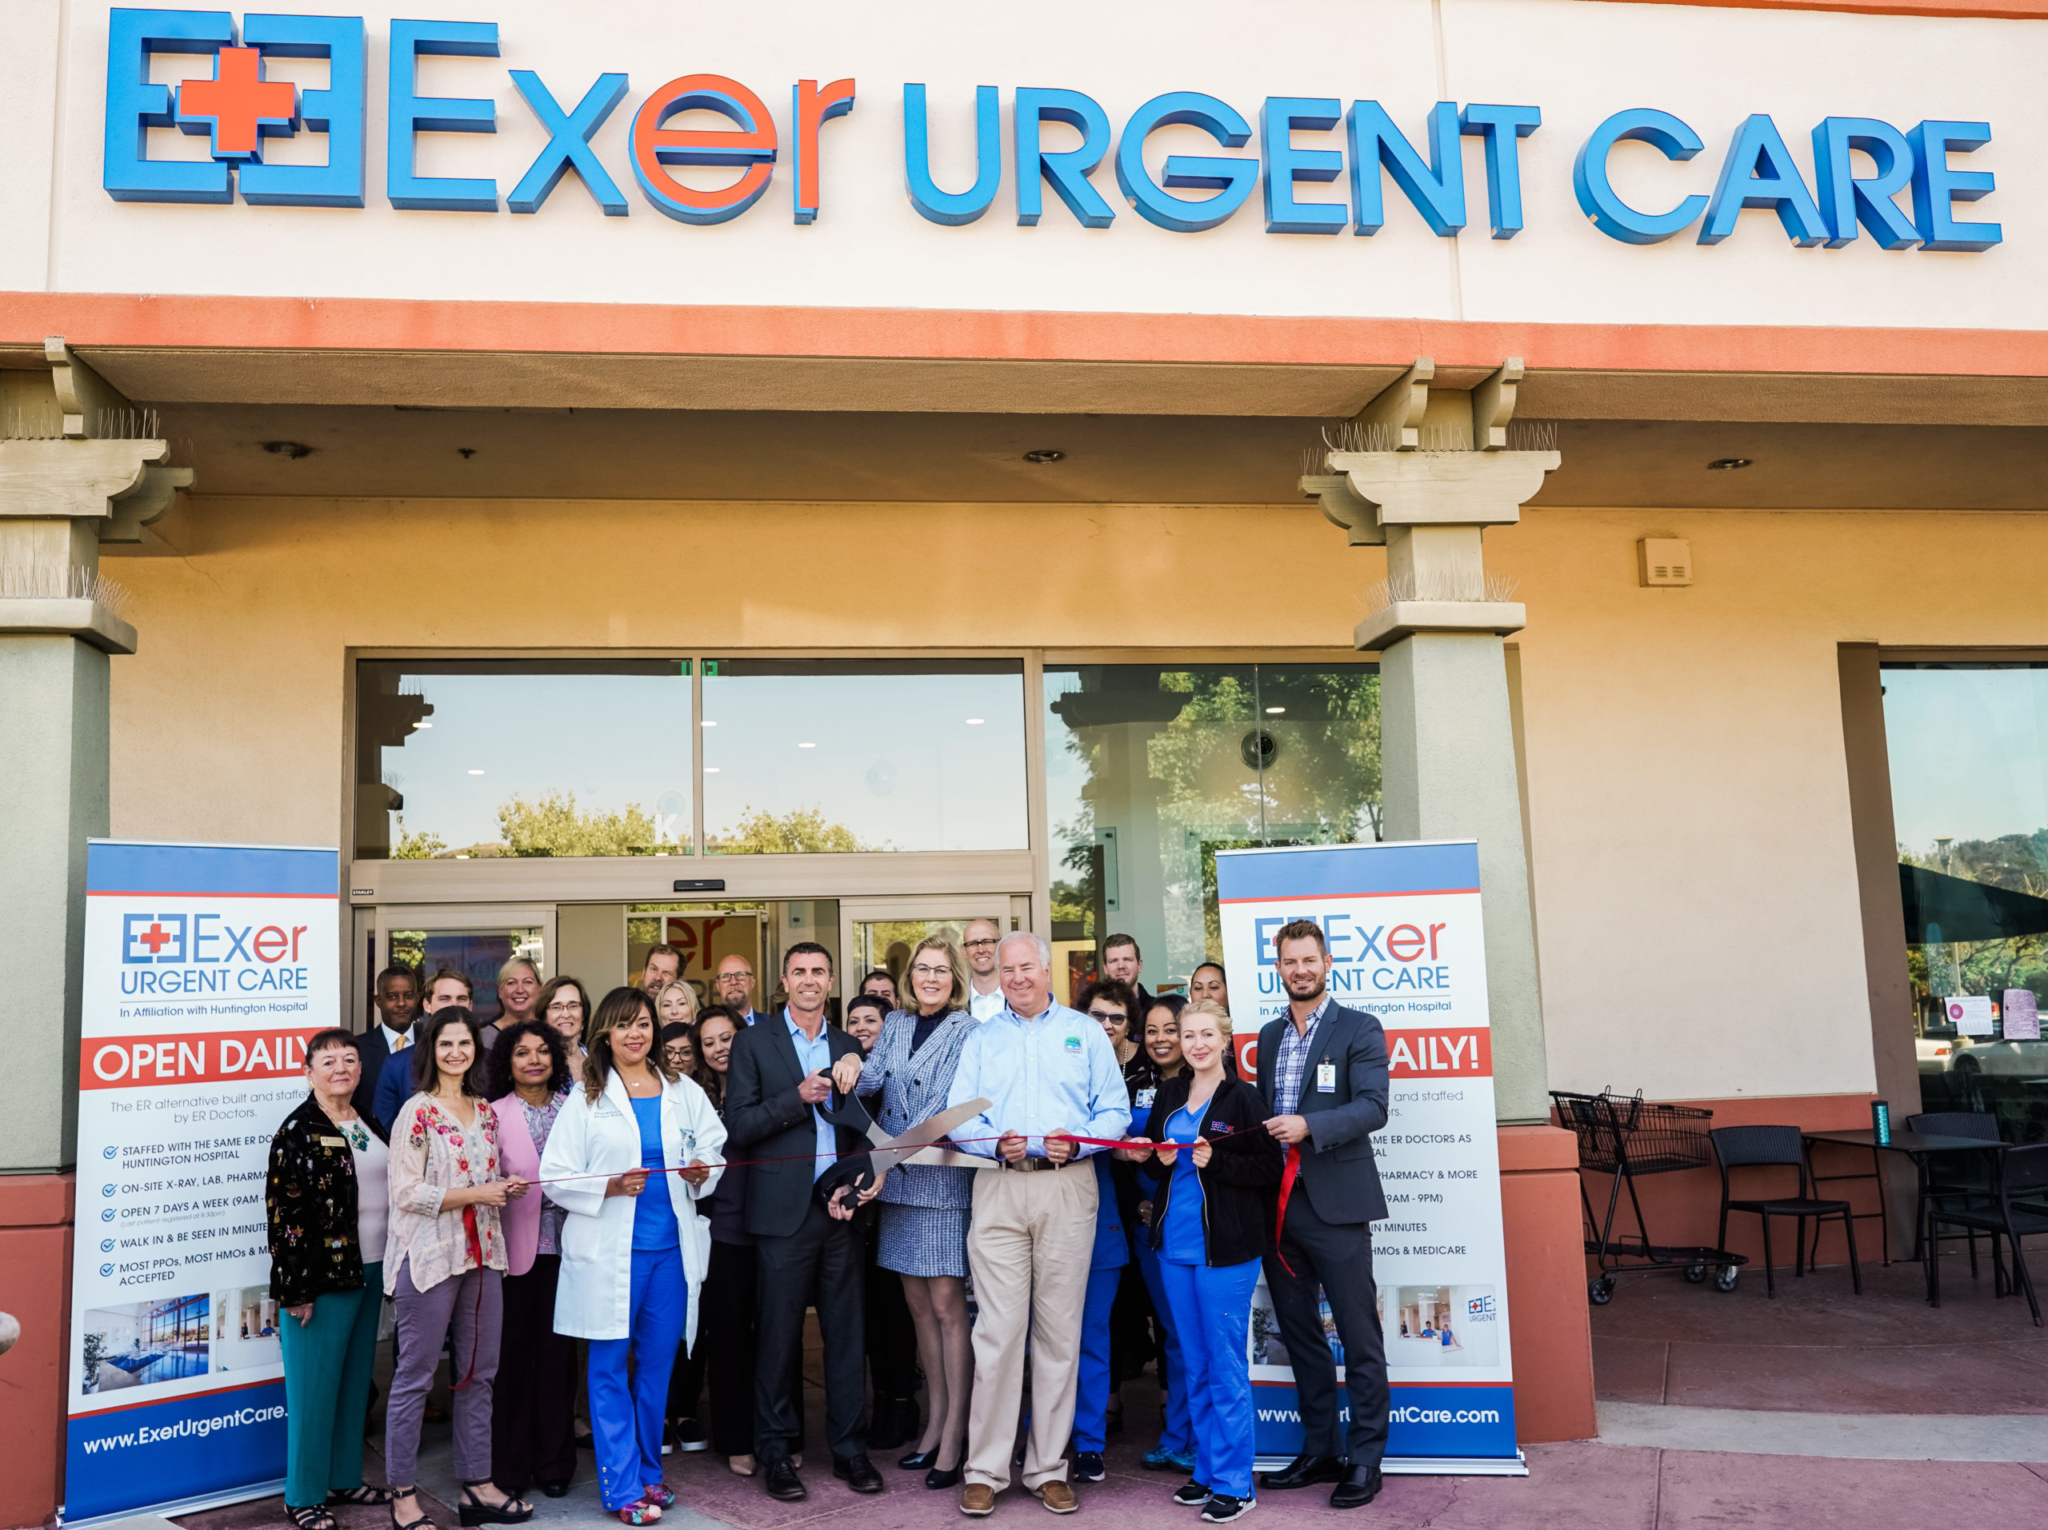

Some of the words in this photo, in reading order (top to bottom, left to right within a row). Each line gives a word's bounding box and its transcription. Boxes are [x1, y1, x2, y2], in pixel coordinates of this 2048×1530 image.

[387, 18, 856, 226] Exer
[903, 82, 1541, 240] URGENT
[1573, 108, 2002, 252] CARE
[193, 914, 307, 963] Exer
[1323, 914, 1446, 962] Exer
[121, 969, 230, 994] URGENT
[237, 967, 307, 991] CARE
[1372, 966, 1450, 990] CARE
[120, 1008, 130, 1017] In
[133, 1007, 183, 1017] Affiliation
[187, 1006, 207, 1016] with
[210, 1004, 266, 1015] Huntington
[269, 1002, 308, 1013] Hospital
[1259, 1006, 1269, 1015] In
[1408, 1001, 1452, 1013] Hospital
[93, 1041, 205, 1081] OPEN
[1388, 1035, 1479, 1071] AILY!
[111, 1101, 132, 1112] The
[136, 1100, 152, 1111] ER
[155, 1097, 219, 1110] alternative
[223, 1094, 247, 1105] built
[250, 1091, 273, 1102] and
[1394, 1091, 1419, 1102] and
[1422, 1090, 1464, 1102] staffed
[174, 1112, 189, 1124] by
[192, 1110, 206, 1121] ER
[210, 1108, 257, 1121] Doctors.
[122, 1144, 164, 1156] STAFFED
[167, 1141, 191, 1152] WITH
[194, 1139, 211, 1150] THE
[213, 1137, 241, 1148] SAME
[244, 1136, 256, 1146] ER
[1391, 1135, 1403, 1144] ER
[1405, 1134, 1456, 1144] DOCTORS
[1458, 1134, 1472, 1143] AS
[122, 1155, 191, 1169] HUNTINGTON
[194, 1150, 240, 1163] HOSPITAL
[121, 1181, 163, 1194] ON-SITE
[166, 1178, 199, 1190] X-RAY,
[202, 1174, 223, 1186] LAB,
[1437, 1170, 1445, 1179] &
[1447, 1170, 1478, 1180] MORE
[121, 1206, 150, 1218] OPEN
[154, 1205, 160, 1215] 7
[163, 1202, 189, 1214] DAYS
[192, 1201, 199, 1210] A
[202, 1197, 229, 1209] WEEK
[232, 1194, 259, 1207] (9AM
[1417, 1194, 1443, 1203] 9PM)
[137, 1216, 160, 1227] patient
[161, 1213, 192, 1225] registered
[193, 1212, 200, 1220] at
[1371, 1223, 1381, 1232] IN
[1384, 1223, 1427, 1232] MINUTES
[120, 1237, 149, 1248] WALK
[152, 1235, 163, 1245] IN
[166, 1234, 174, 1243] &
[177, 1232, 188, 1242] BE
[191, 1229, 216, 1239] SEEN
[218, 1227, 229, 1237] IN
[232, 1222, 268, 1235] MINUTE
[119, 1260, 150, 1273] MOST
[152, 1257, 182, 1269] PPOs,
[185, 1254, 213, 1265] MOST
[216, 1249, 246, 1260] HMOs
[248, 1247, 256, 1256] &
[1403, 1246, 1410, 1255] &
[1413, 1245, 1467, 1255] MEDICARE
[119, 1270, 175, 1286] ACCEPTED
[83, 1405, 288, 1454] www.ExerUrgentCare.
